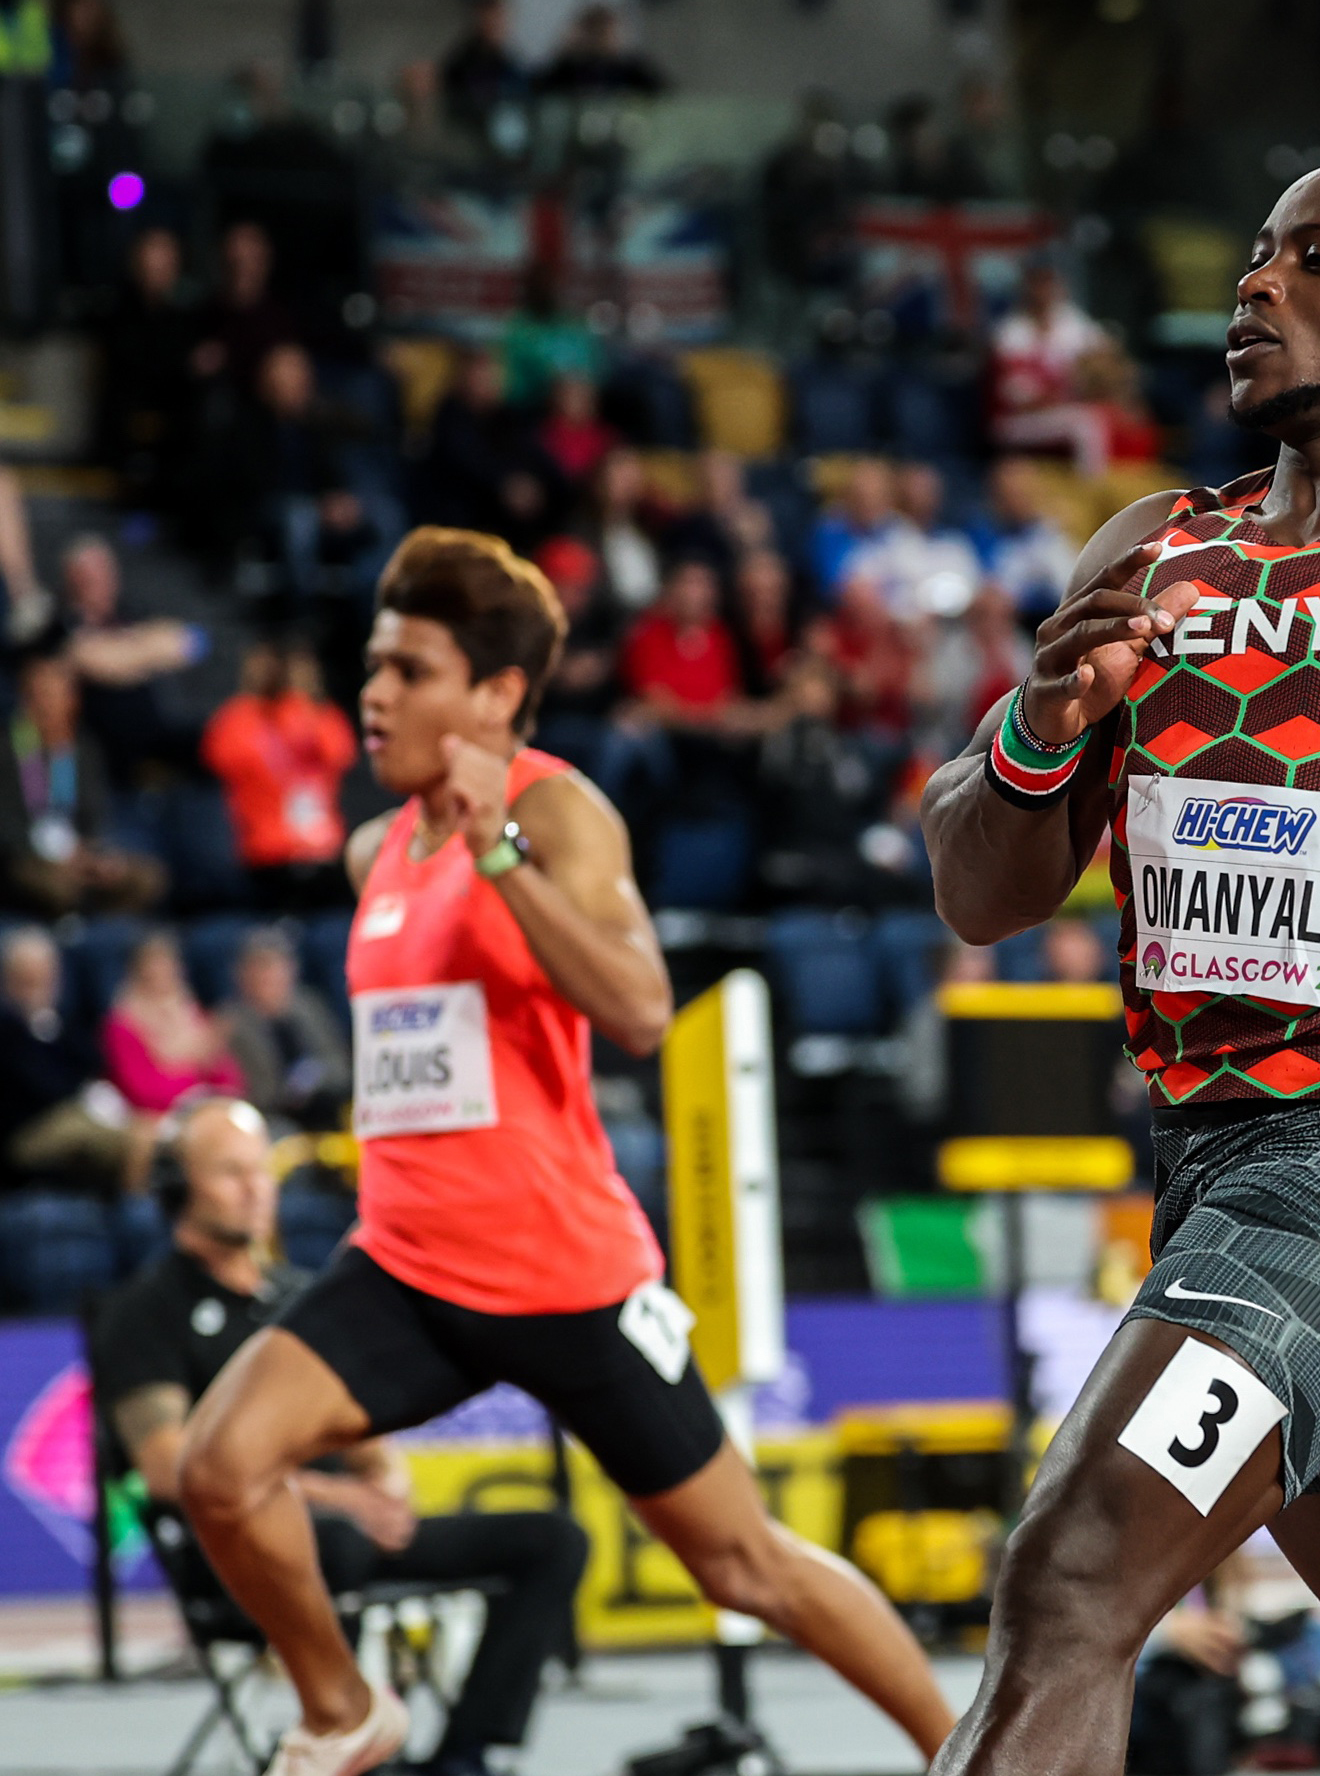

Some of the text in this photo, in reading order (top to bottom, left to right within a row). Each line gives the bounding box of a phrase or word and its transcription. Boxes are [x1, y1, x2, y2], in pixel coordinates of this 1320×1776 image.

[1173, 797, 1317, 856] HI-CHEW
[1170, 951, 1309, 986] GLASGOW
[367, 1045, 453, 1094] LOUIS
[1167, 1377, 1240, 1469] 3
